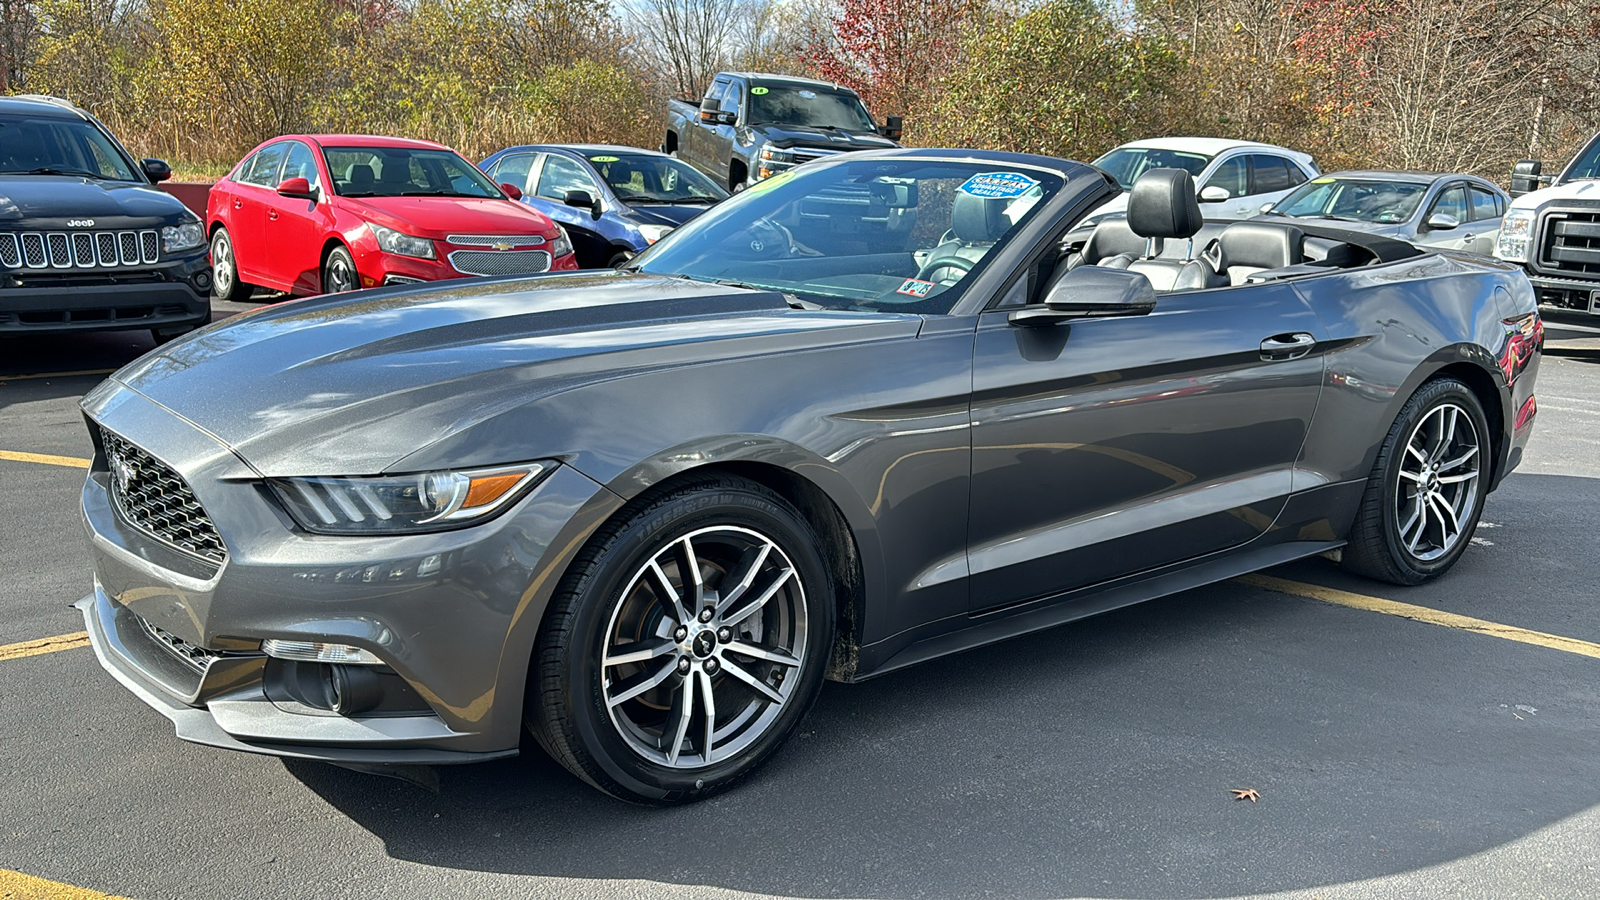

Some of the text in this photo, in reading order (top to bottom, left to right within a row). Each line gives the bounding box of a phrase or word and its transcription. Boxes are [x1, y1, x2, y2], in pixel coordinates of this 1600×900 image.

[969, 183, 1017, 193] ADVANTAGE
[971, 189, 1002, 197] DEALER
[67, 219, 95, 227] Jeep
[637, 506, 683, 542] TIGER
[698, 494, 734, 508] PAW
